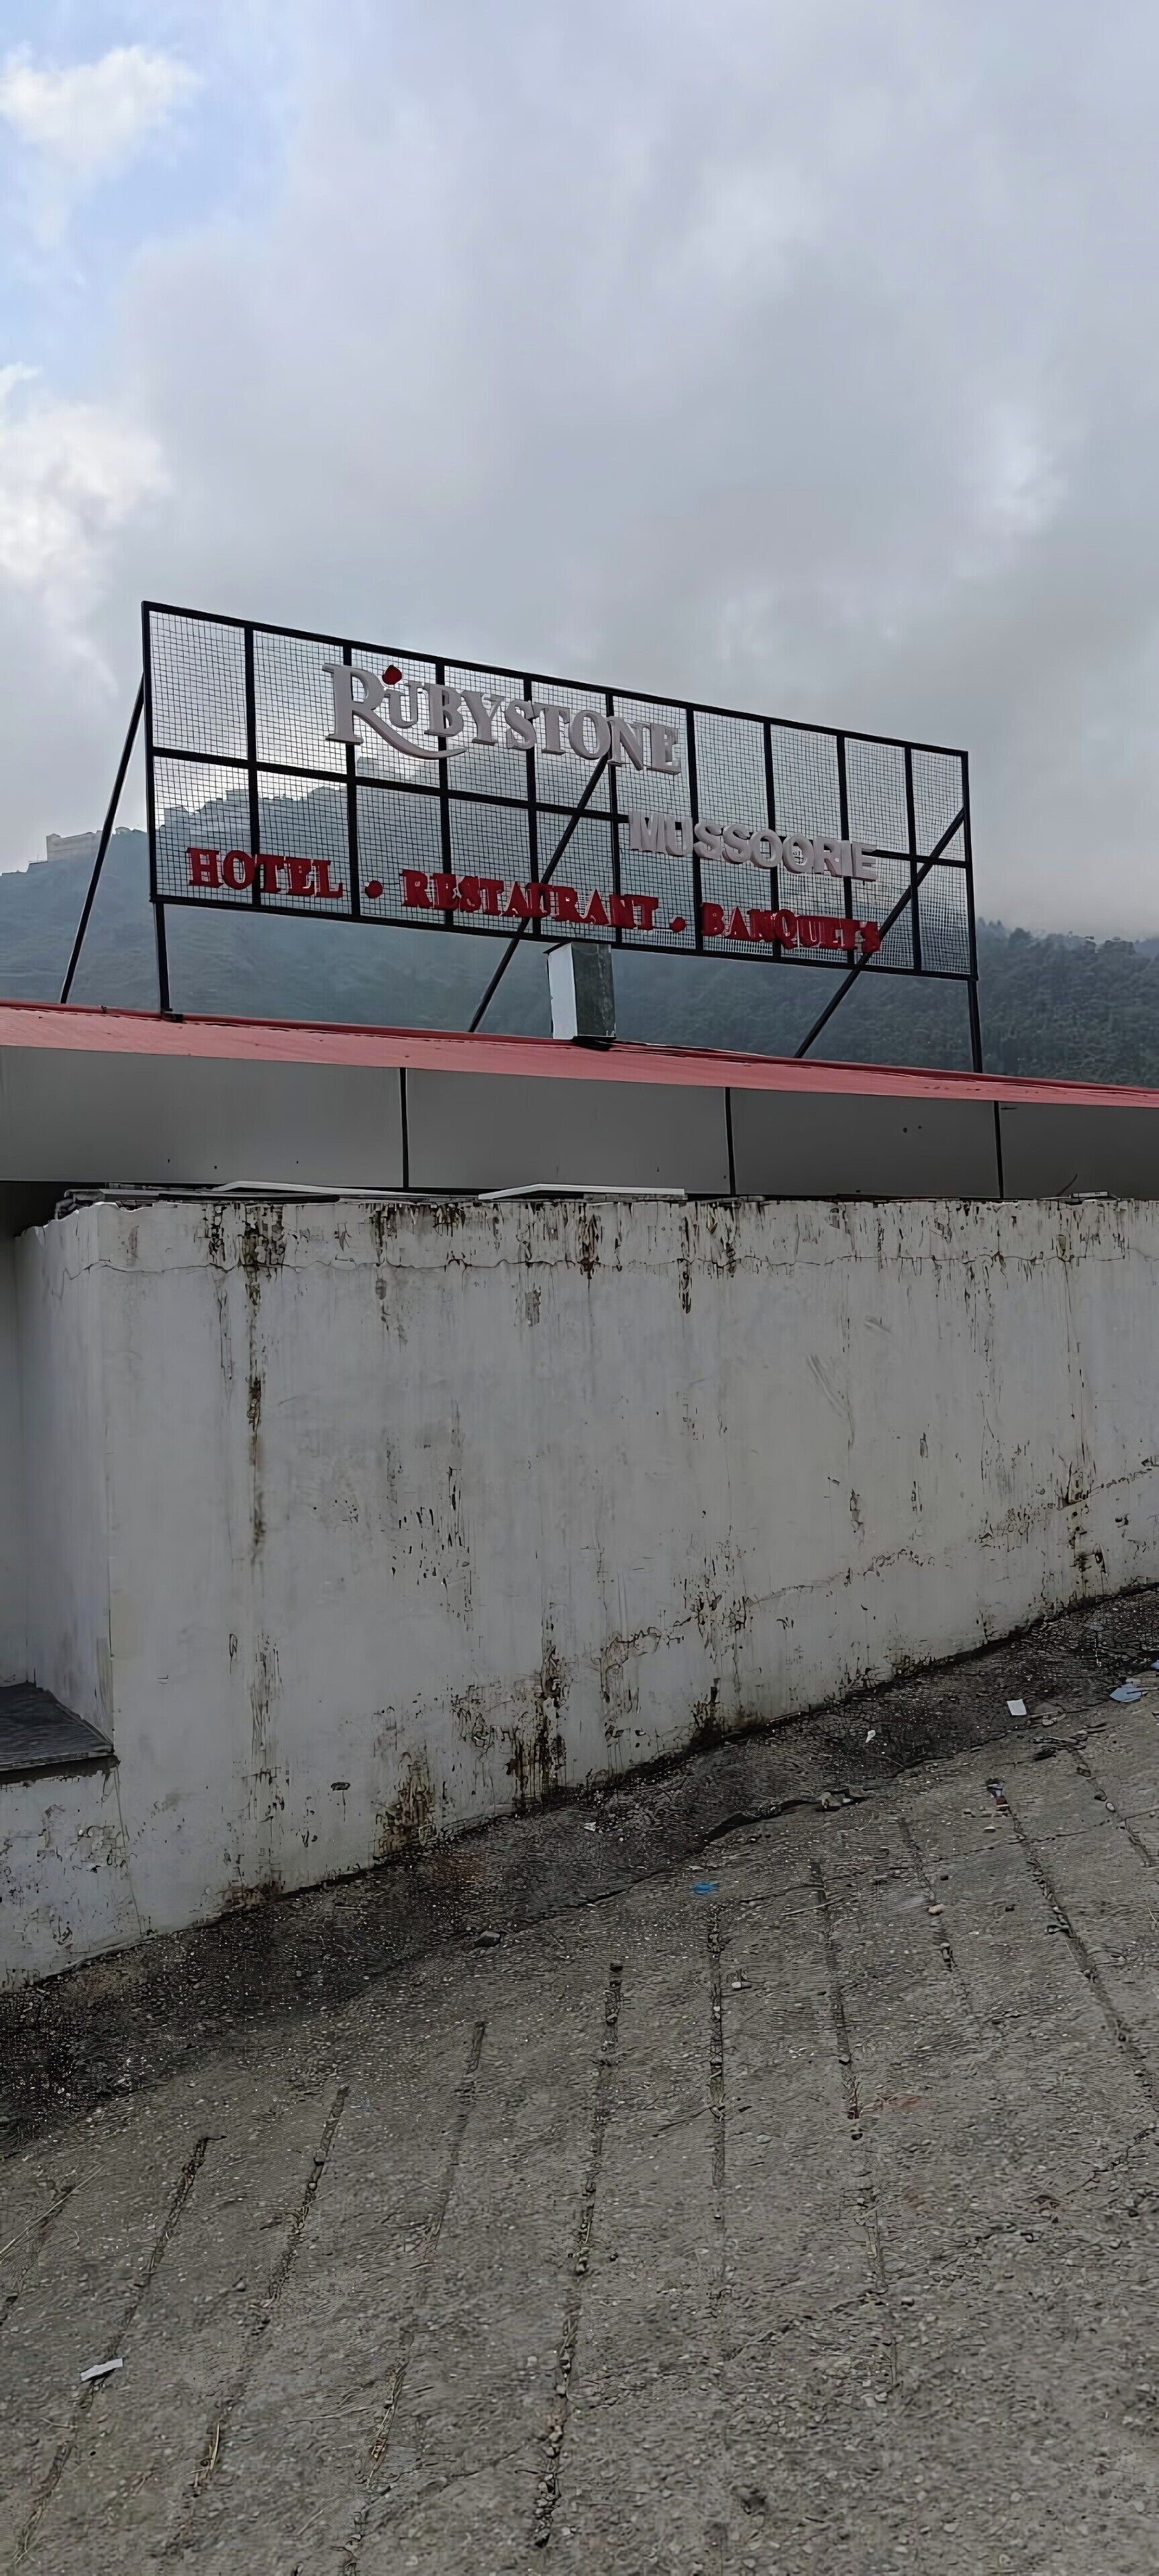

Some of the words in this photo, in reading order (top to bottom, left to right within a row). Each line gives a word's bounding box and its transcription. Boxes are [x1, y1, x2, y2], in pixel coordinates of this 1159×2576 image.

[322, 663, 682, 775] RUBYSTONE
[628, 811, 877, 881] MUSSOORIE
[187, 847, 343, 898] HOTEL
[399, 869, 658, 930] RESTAURANT
[700, 902, 881, 953] BANQUETS
